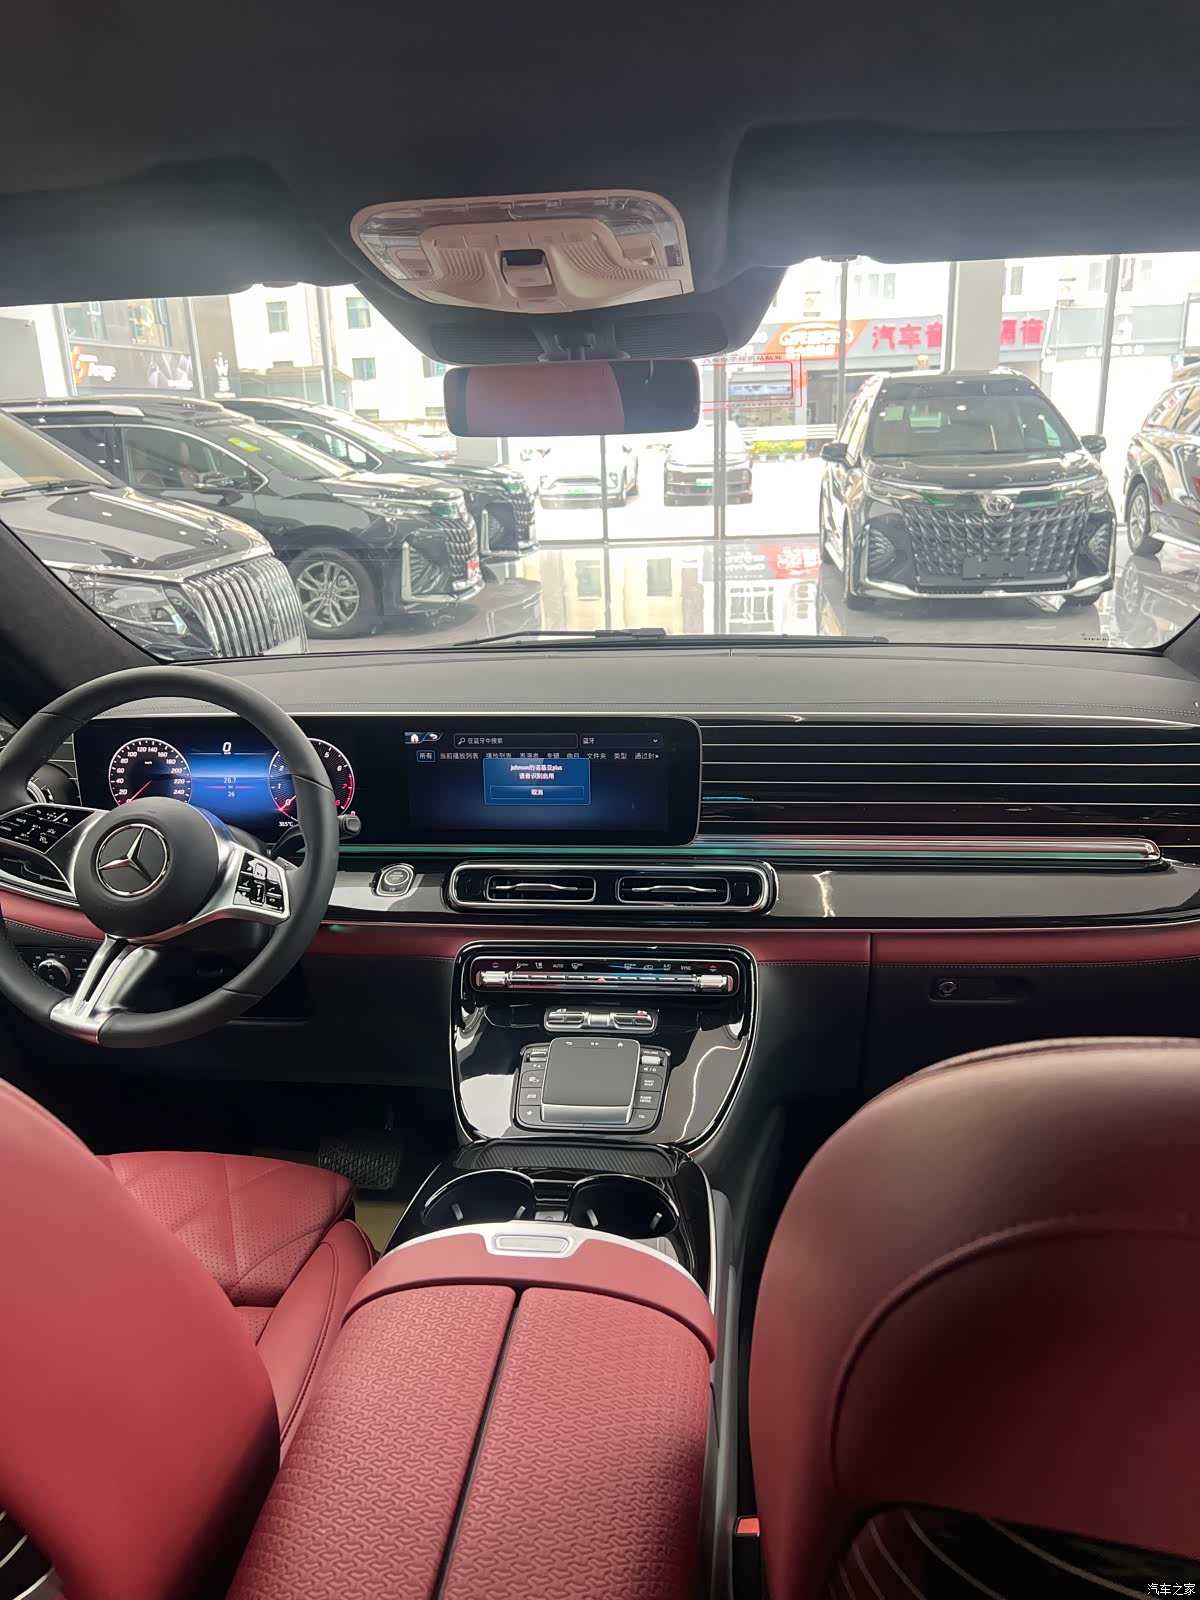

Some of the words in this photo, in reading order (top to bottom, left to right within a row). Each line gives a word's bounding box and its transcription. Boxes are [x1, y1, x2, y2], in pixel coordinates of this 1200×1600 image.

[582, 737, 595, 745] 蓝牙
[222, 741, 232, 752] 0
[419, 752, 433, 760] 所有
[440, 752, 479, 760] 当前播放列表
[587, 752, 607, 760] 文件夹
[613, 752, 628, 760] 类型
